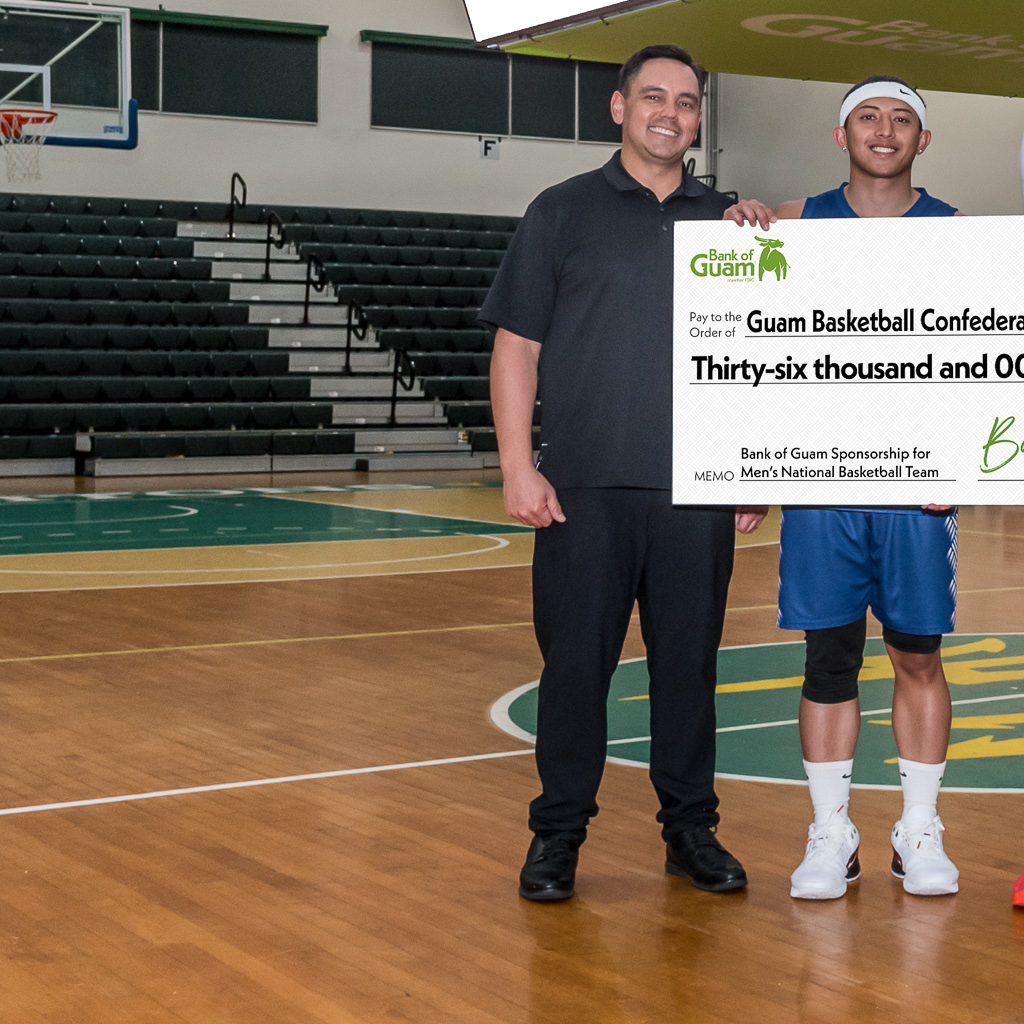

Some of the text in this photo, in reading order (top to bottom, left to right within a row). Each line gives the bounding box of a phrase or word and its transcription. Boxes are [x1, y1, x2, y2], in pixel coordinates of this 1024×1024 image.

[484, 140, 496, 156] F
[709, 249, 755, 261] Bank of
[690, 311, 742, 325] Pay to the
[747, 310, 806, 333] Guam
[813, 308, 915, 332] Basketball
[690, 327, 736, 338] Order of
[691, 355, 808, 387] Thirty-six
[813, 354, 933, 380] thousand
[939, 354, 988, 380] and
[741, 447, 931, 463] Bank of Guam Sponsorship for
[694, 471, 735, 482] MEMO
[781, 465, 835, 478] National
[839, 465, 902, 478] Basketball
[905, 465, 939, 478] Team
